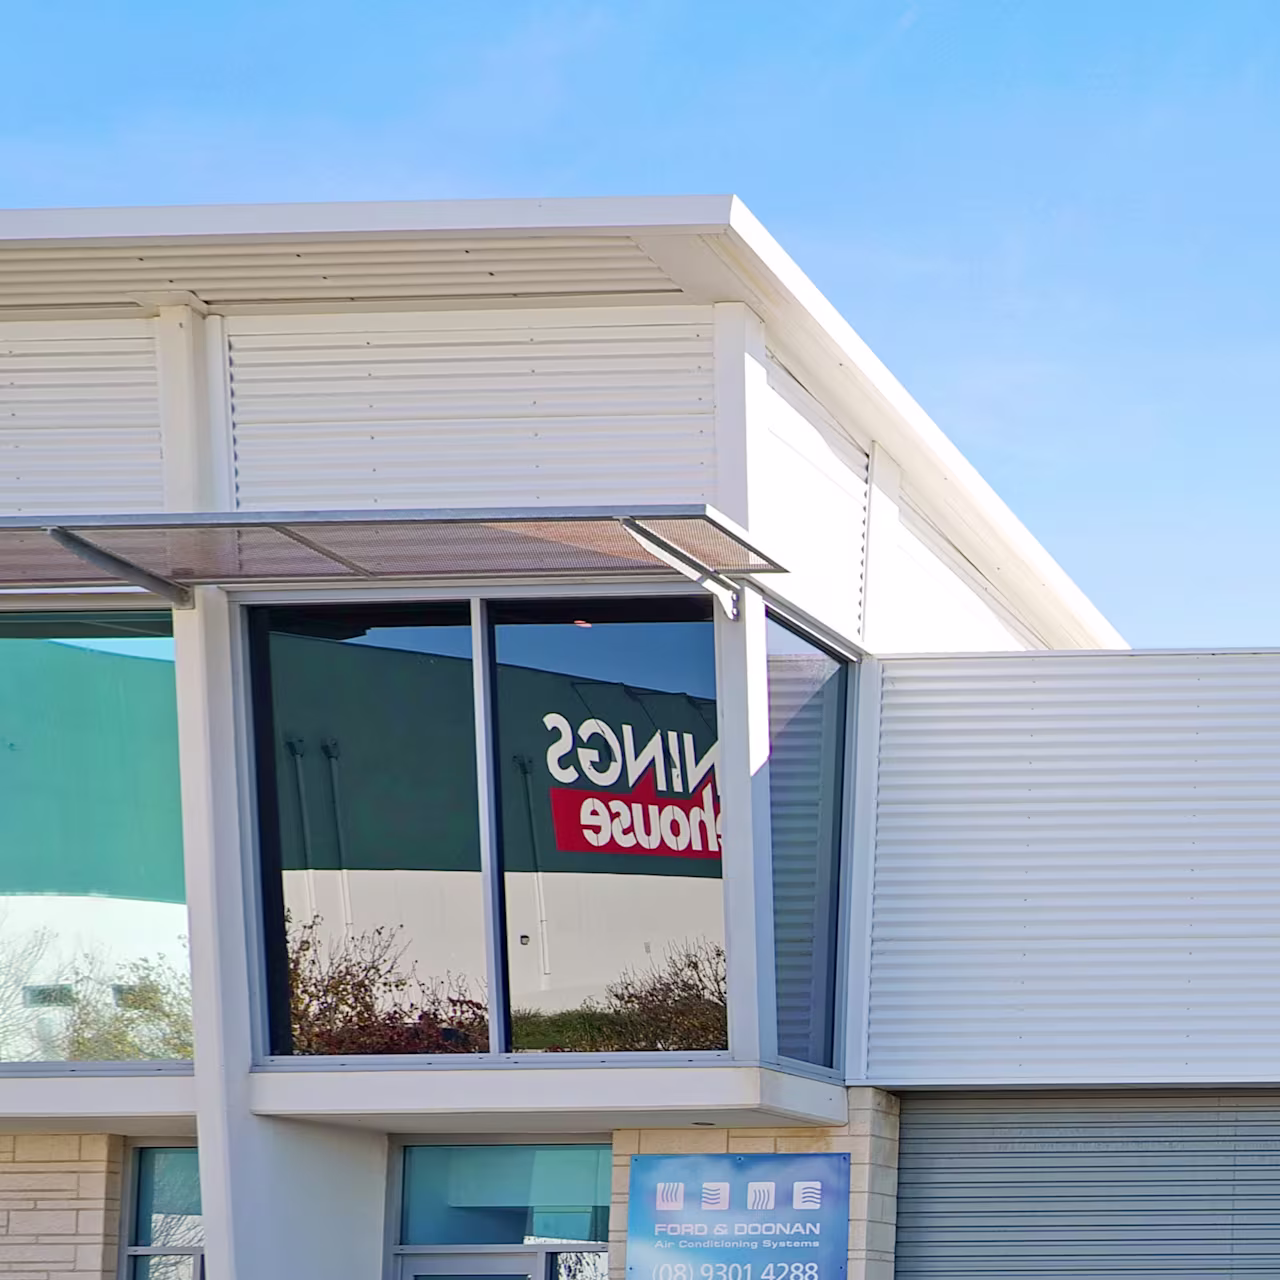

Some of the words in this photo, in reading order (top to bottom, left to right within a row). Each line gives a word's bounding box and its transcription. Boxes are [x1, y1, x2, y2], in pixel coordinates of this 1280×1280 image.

[654, 1223, 708, 1236] FORD
[713, 1223, 729, 1236] &
[734, 1222, 821, 1236] DOONAN
[654, 1240, 675, 1249] Air
[678, 1239, 758, 1250] Conditioning
[762, 1239, 820, 1249] Systems
